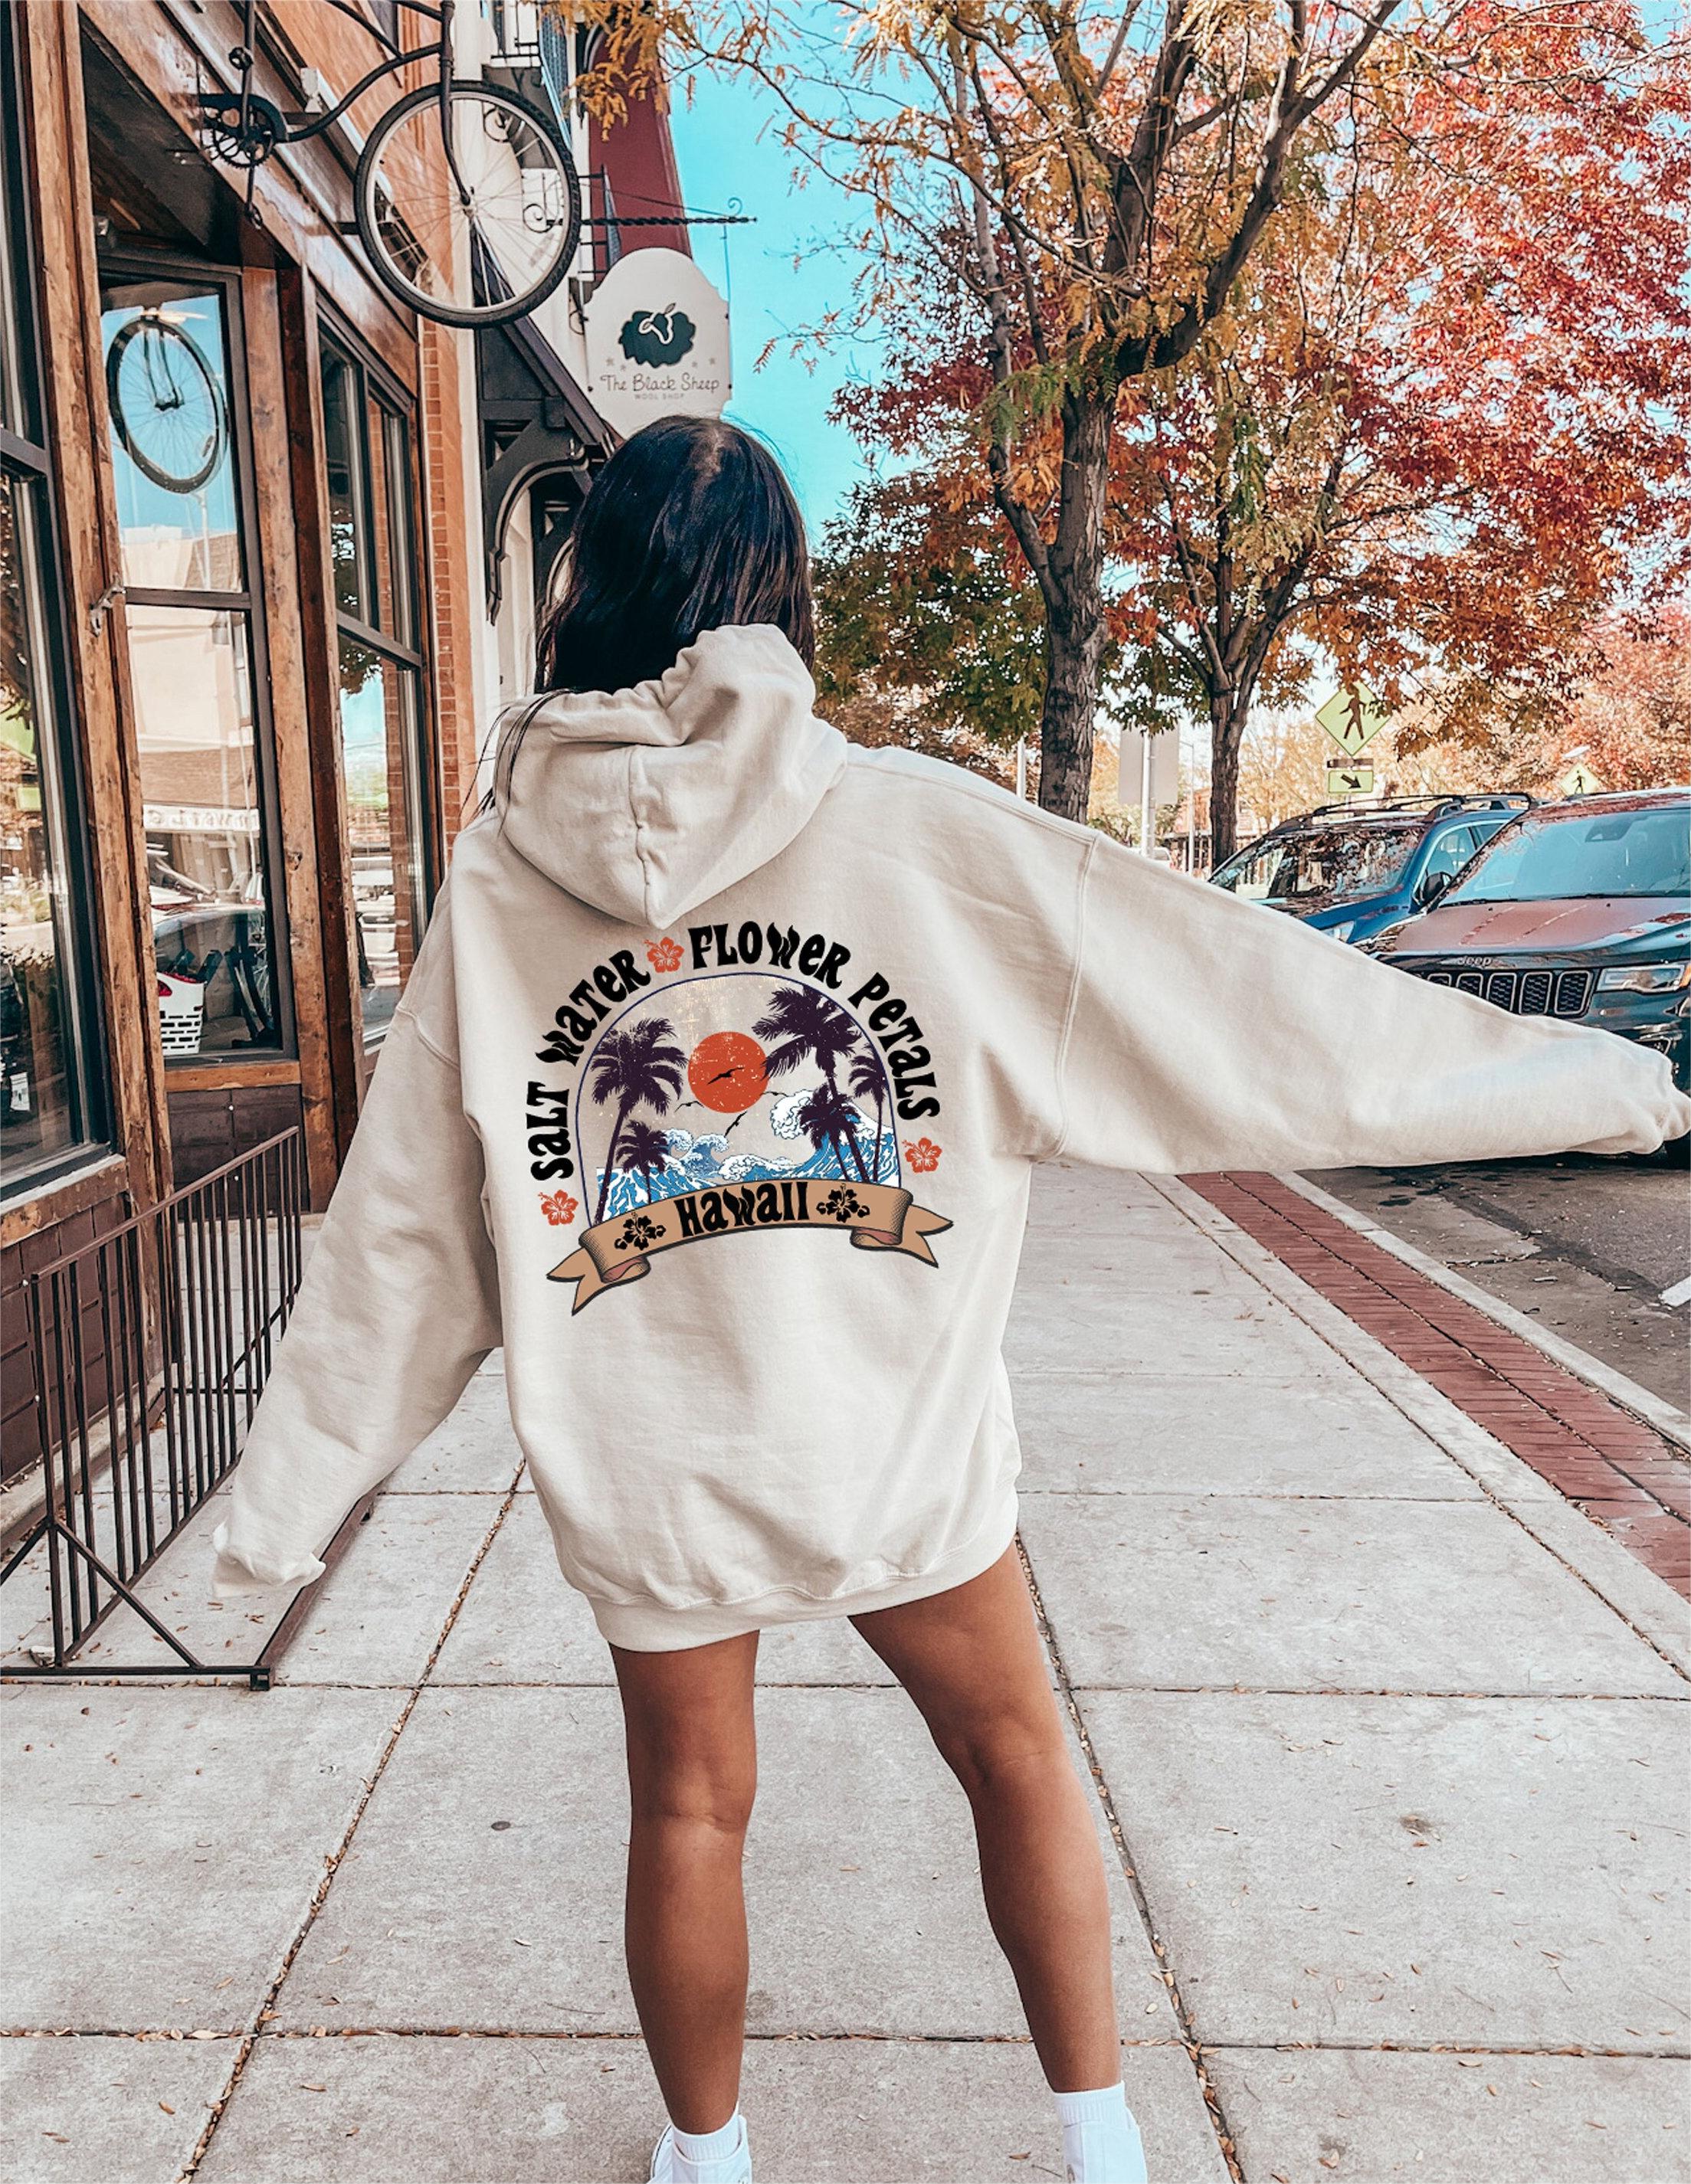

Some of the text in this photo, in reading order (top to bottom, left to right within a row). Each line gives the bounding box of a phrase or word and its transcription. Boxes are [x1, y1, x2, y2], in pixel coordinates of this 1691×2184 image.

[601, 372, 719, 394] The Black Sheep
[1457, 955, 1492, 967] Jeep
